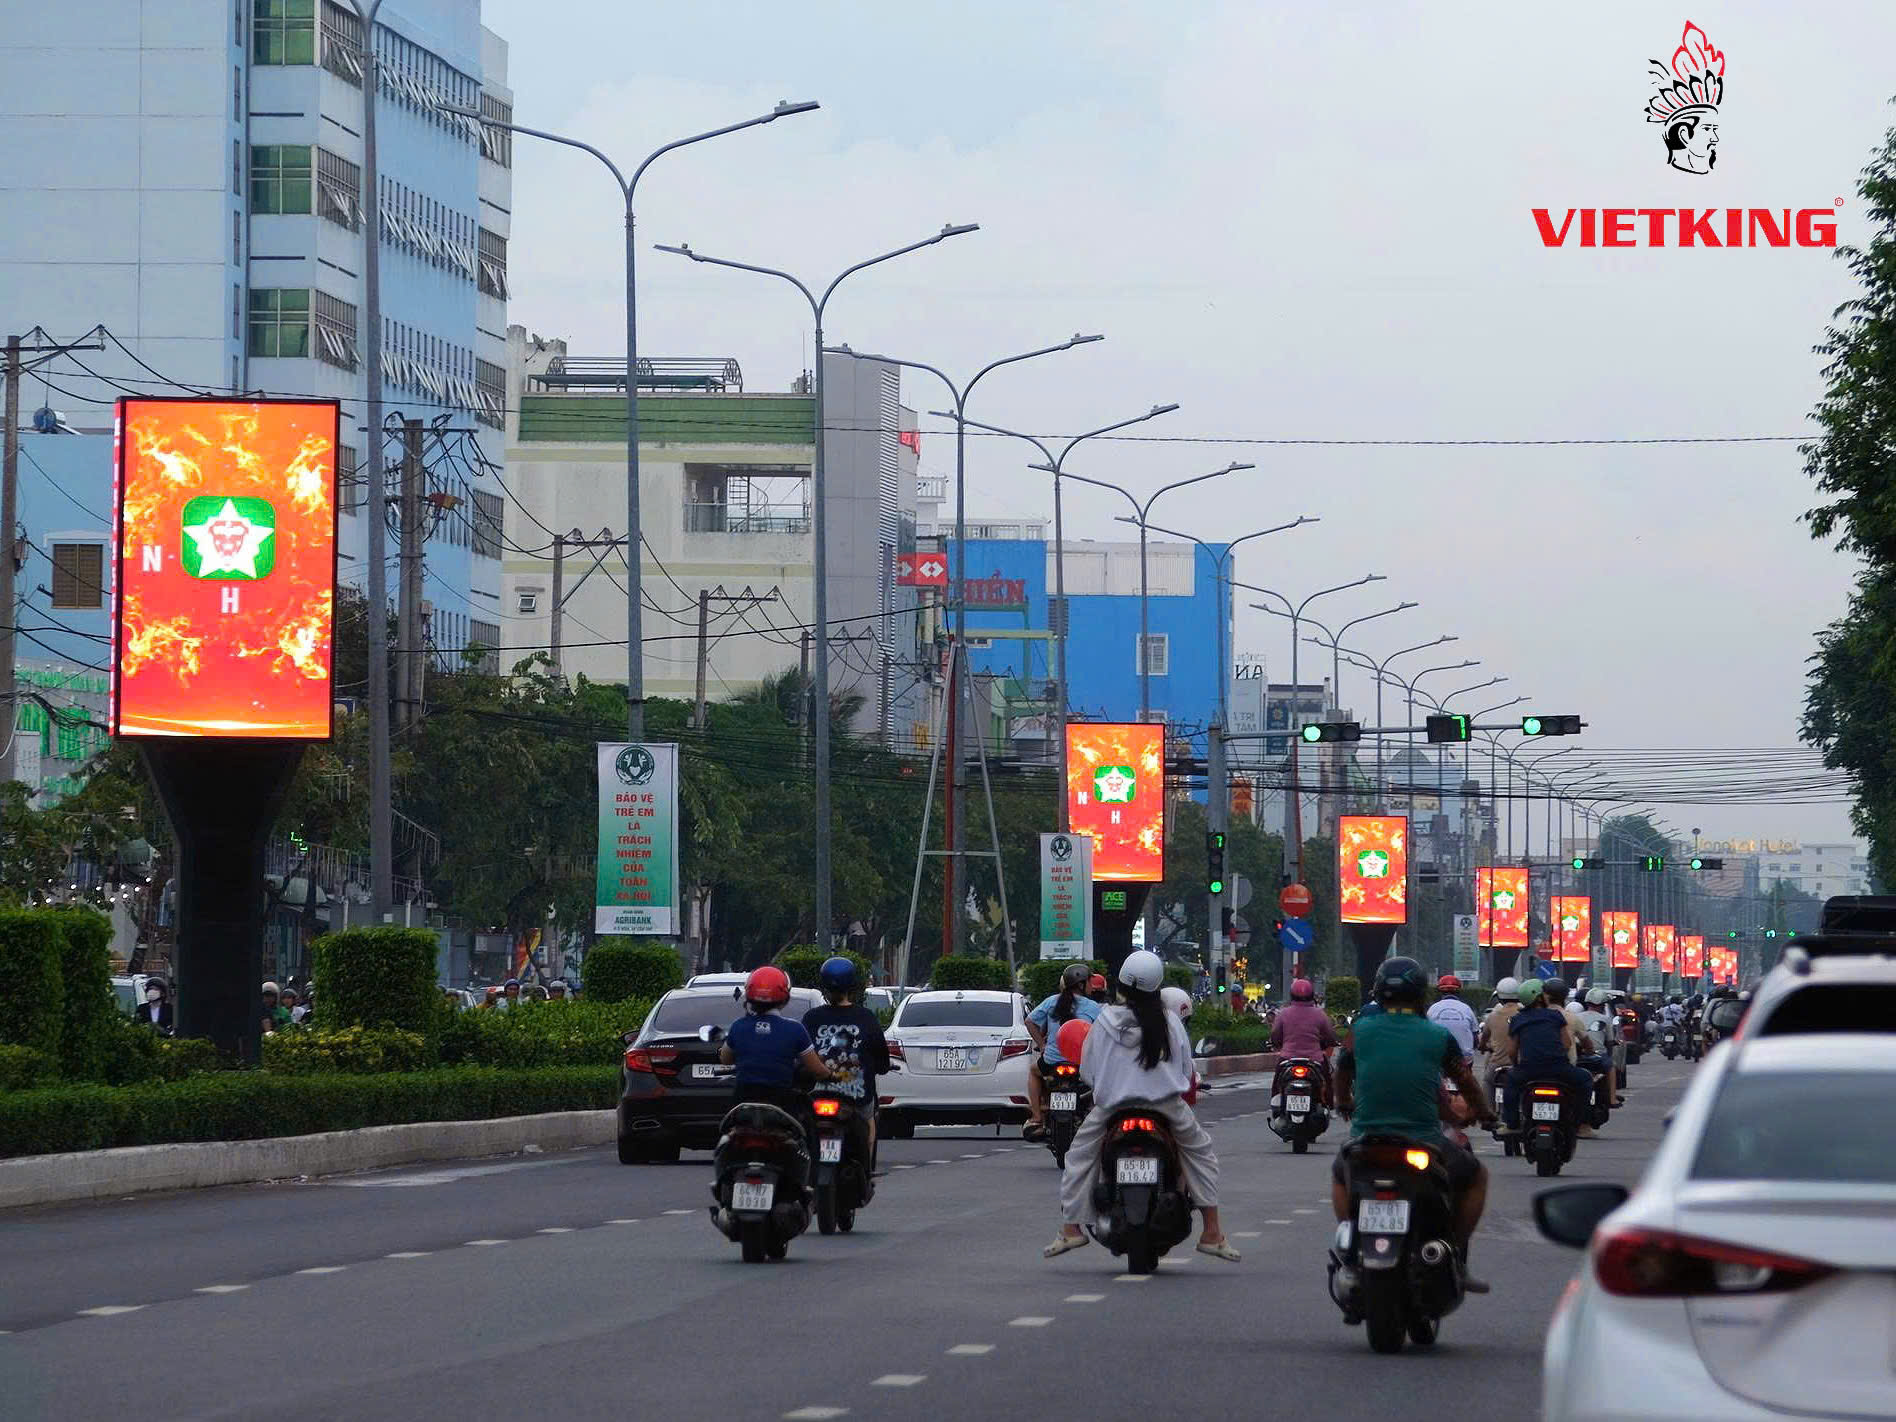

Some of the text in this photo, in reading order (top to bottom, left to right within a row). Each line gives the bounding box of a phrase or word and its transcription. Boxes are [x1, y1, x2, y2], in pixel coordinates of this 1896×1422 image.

[143, 545, 161, 572] N
[221, 587, 239, 614] H
[637, 808, 654, 817] EM
[615, 916, 652, 925] AGRIBANK
